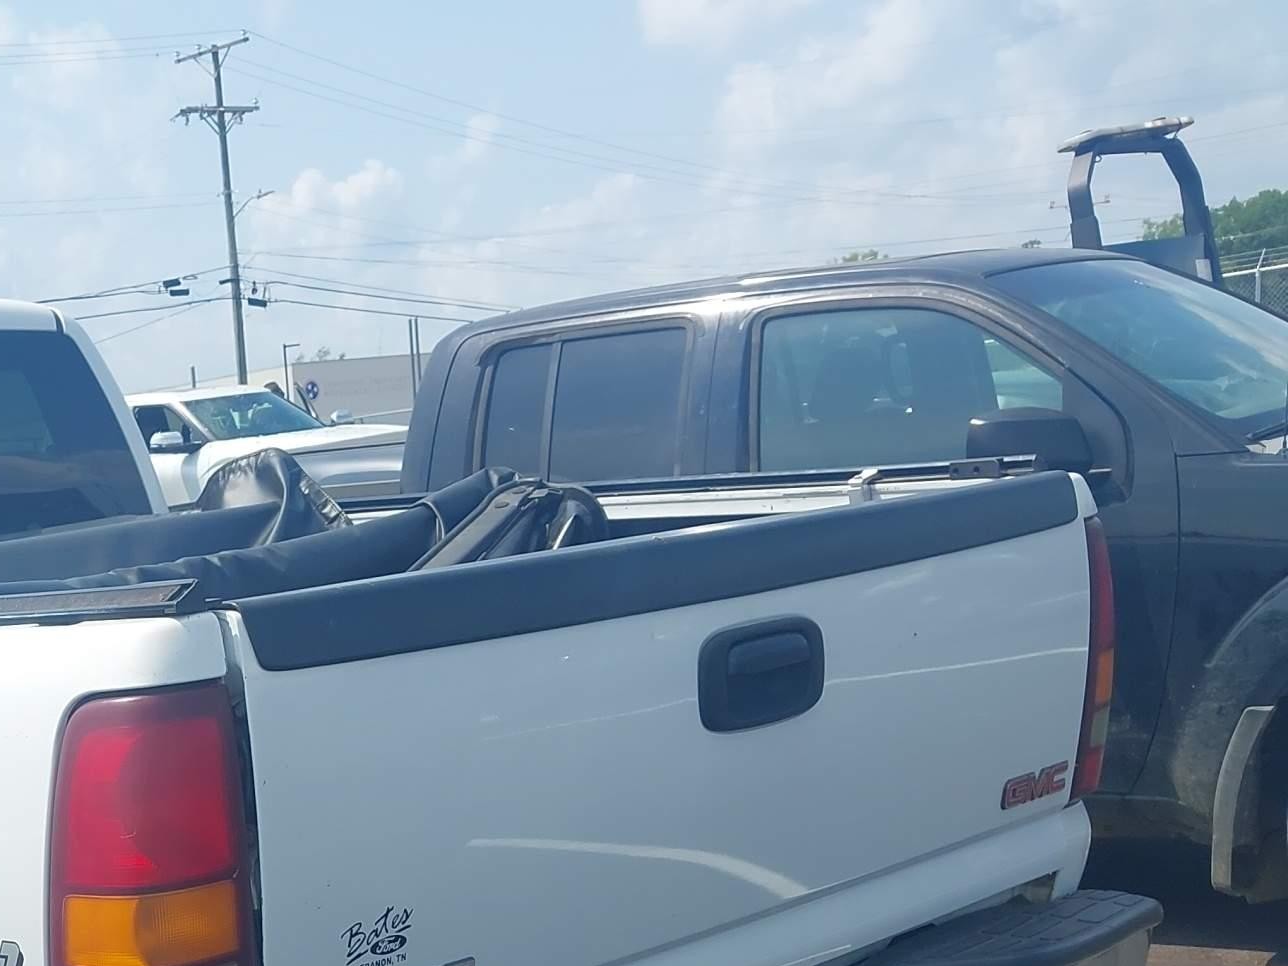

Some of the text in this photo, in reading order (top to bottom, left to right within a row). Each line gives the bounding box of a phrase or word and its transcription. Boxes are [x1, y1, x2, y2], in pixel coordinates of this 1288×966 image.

[1000, 760, 1069, 811] GMC
[340, 905, 414, 959] Bates
[372, 935, 405, 955] Ford
[396, 952, 408, 963] TN
